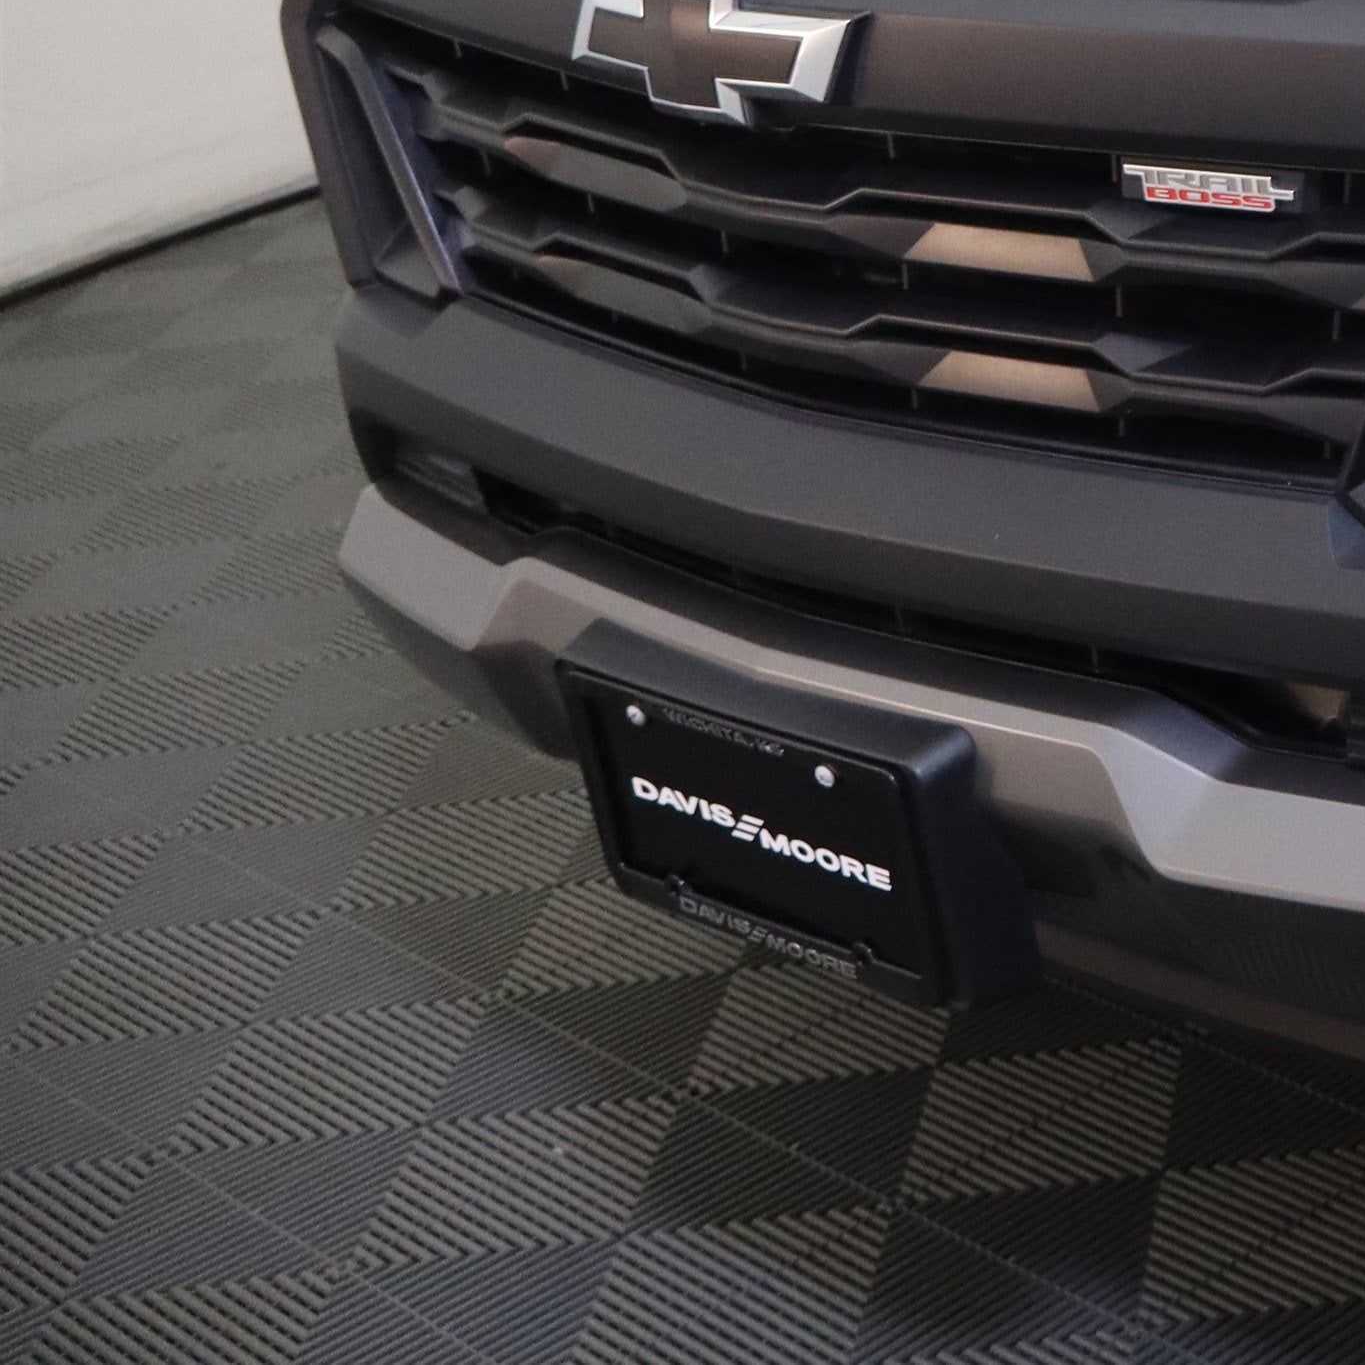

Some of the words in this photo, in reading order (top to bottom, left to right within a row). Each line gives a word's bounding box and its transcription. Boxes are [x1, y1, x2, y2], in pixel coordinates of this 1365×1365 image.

[1122, 163, 1295, 201] TRAIL
[1146, 186, 1274, 211] BOSS
[631, 776, 735, 828] DAVIS
[759, 827, 892, 892] MOORE
[679, 895, 751, 935] DAVIS
[765, 933, 858, 980] MOORE
